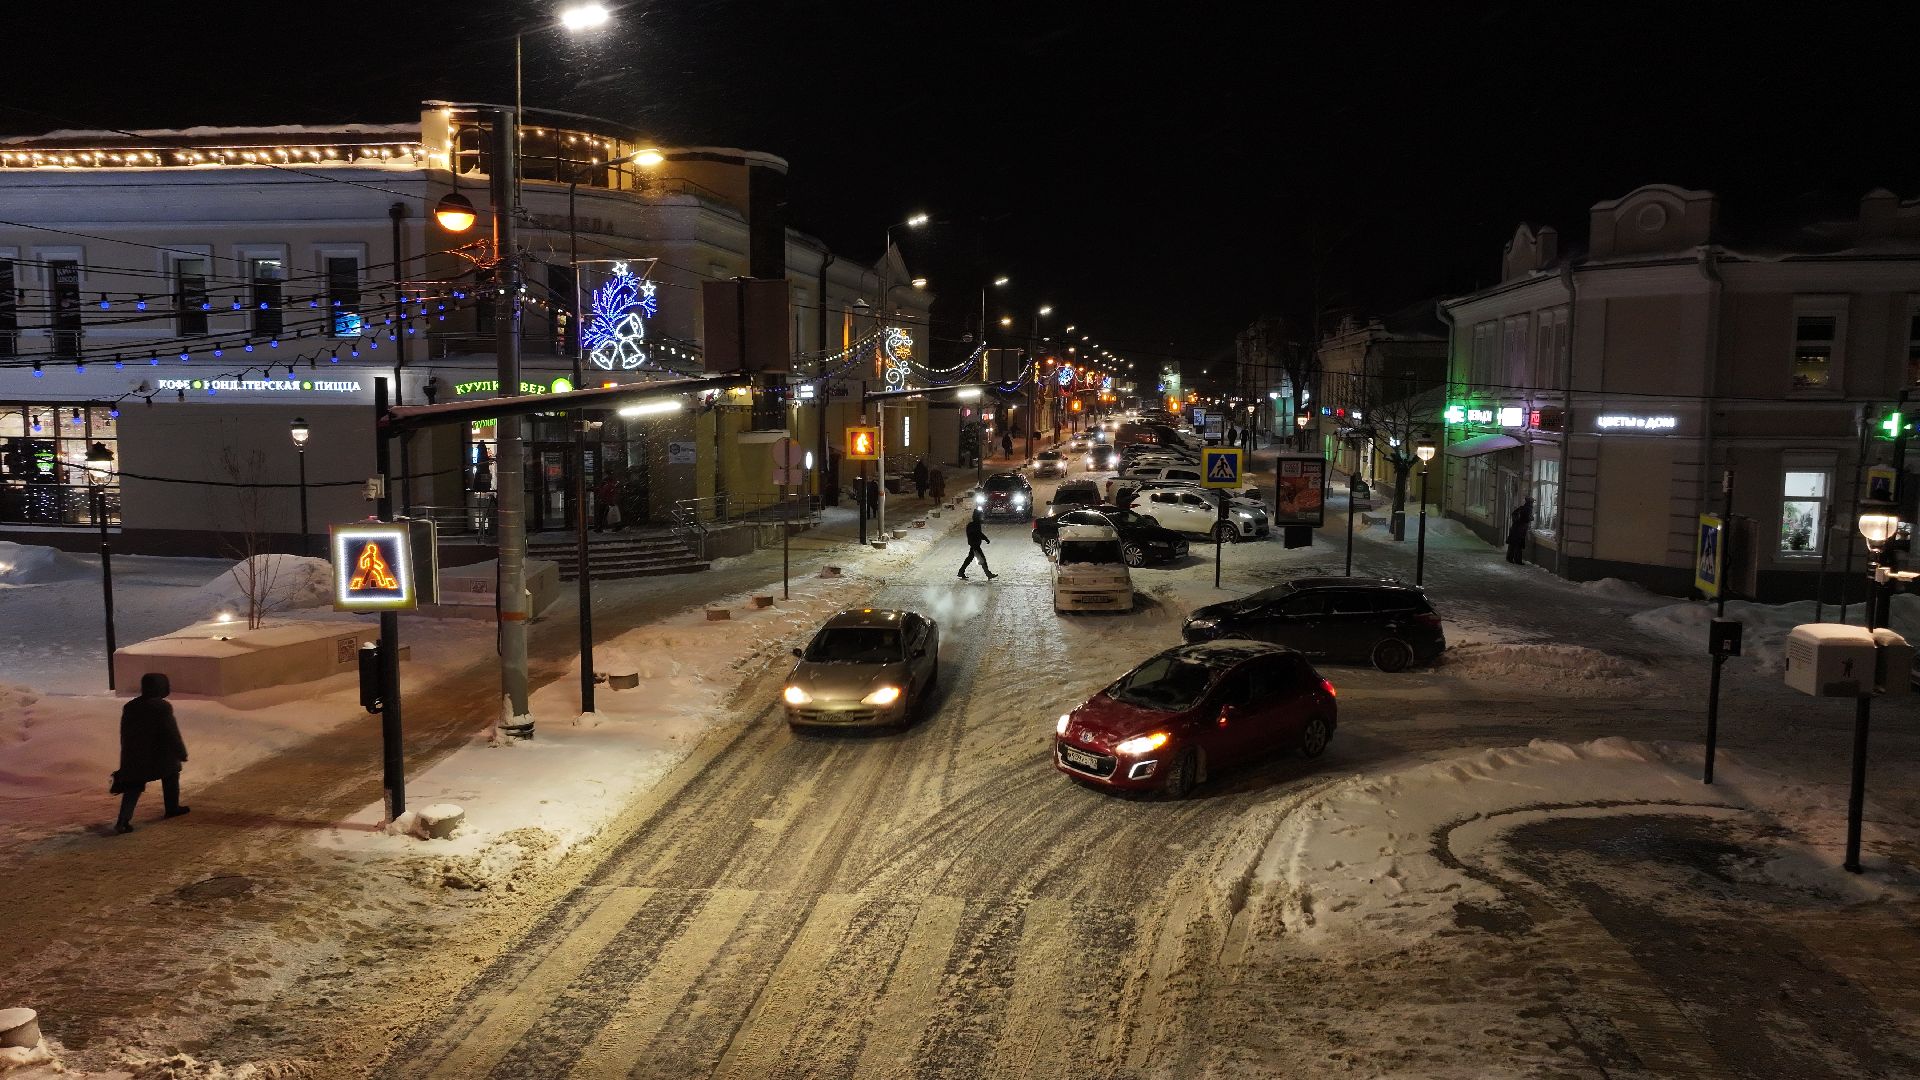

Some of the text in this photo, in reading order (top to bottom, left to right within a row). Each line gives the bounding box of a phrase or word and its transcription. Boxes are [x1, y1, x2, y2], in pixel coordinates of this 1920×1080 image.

[158, 379, 191, 390] КОФЕ
[314, 380, 362, 393] ПИЦЦА
[455, 380, 546, 395] КУУЛКВЕР
[1597, 416, 1637, 430] ЦВЕТЫ
[1645, 417, 1676, 430] ДОМ
